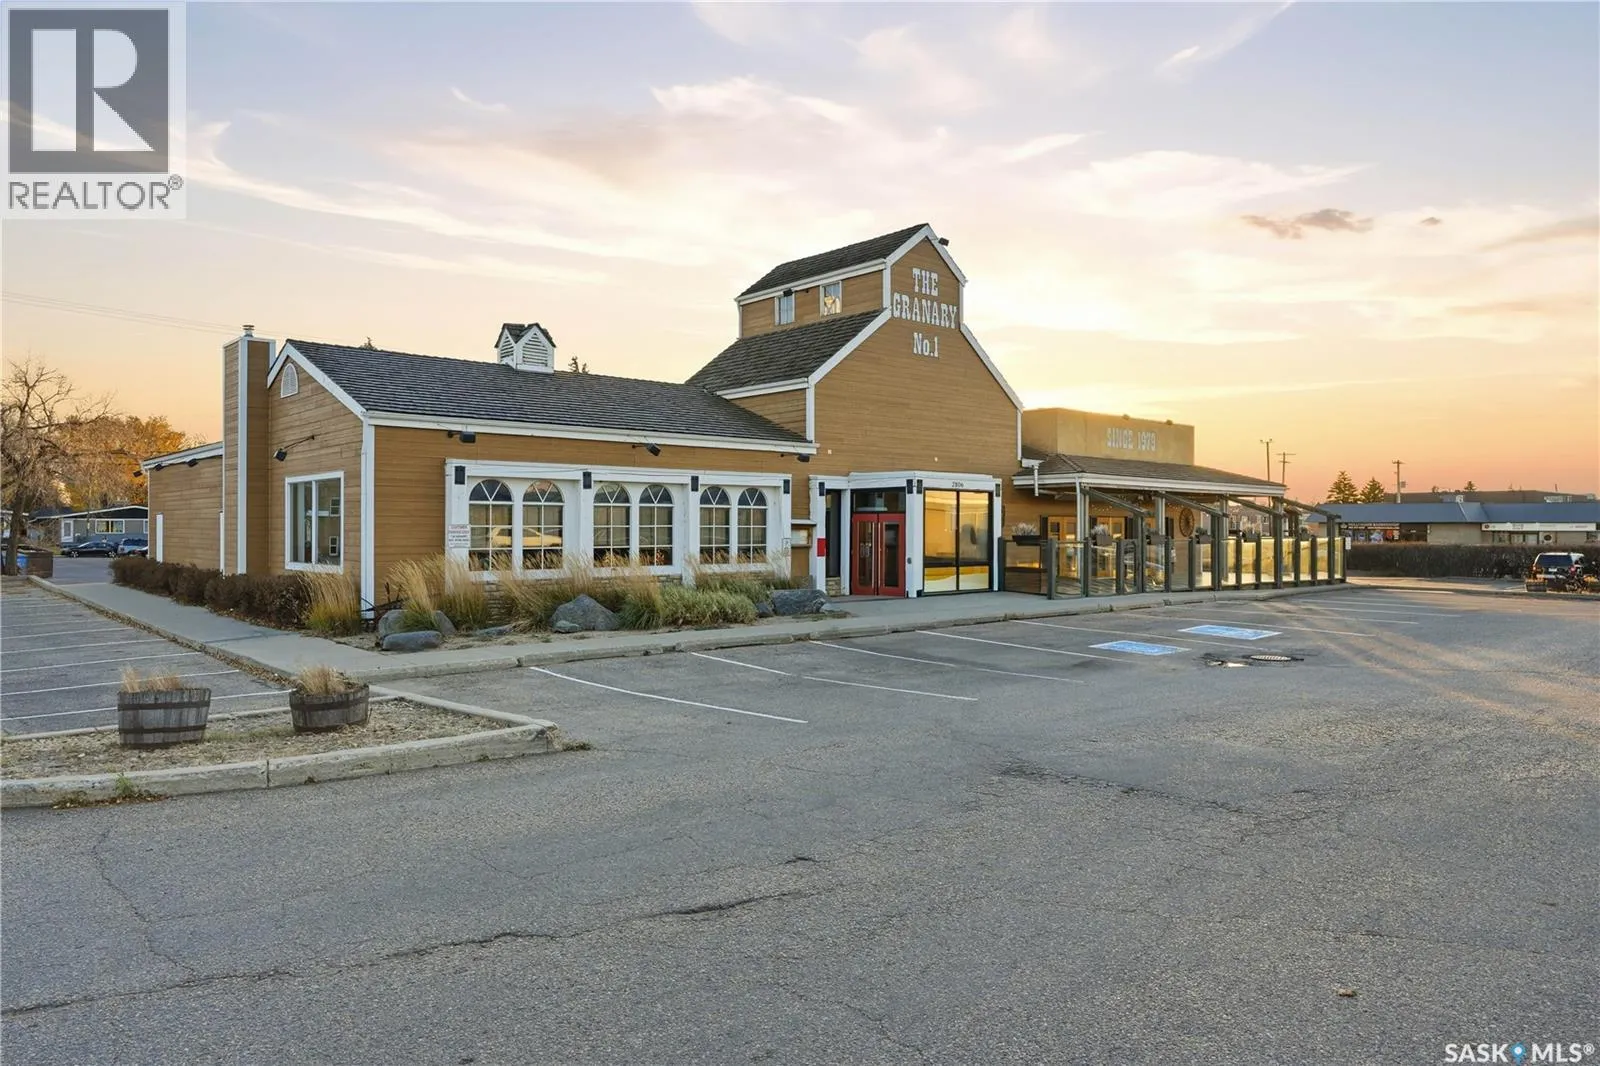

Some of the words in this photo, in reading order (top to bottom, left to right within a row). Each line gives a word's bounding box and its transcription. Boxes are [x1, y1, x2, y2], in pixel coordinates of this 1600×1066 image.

[912, 267, 939, 296] THE
[893, 292, 958, 329] GRANARY
[913, 332, 939, 358] No.1
[1106, 427, 1134, 449] SINCE
